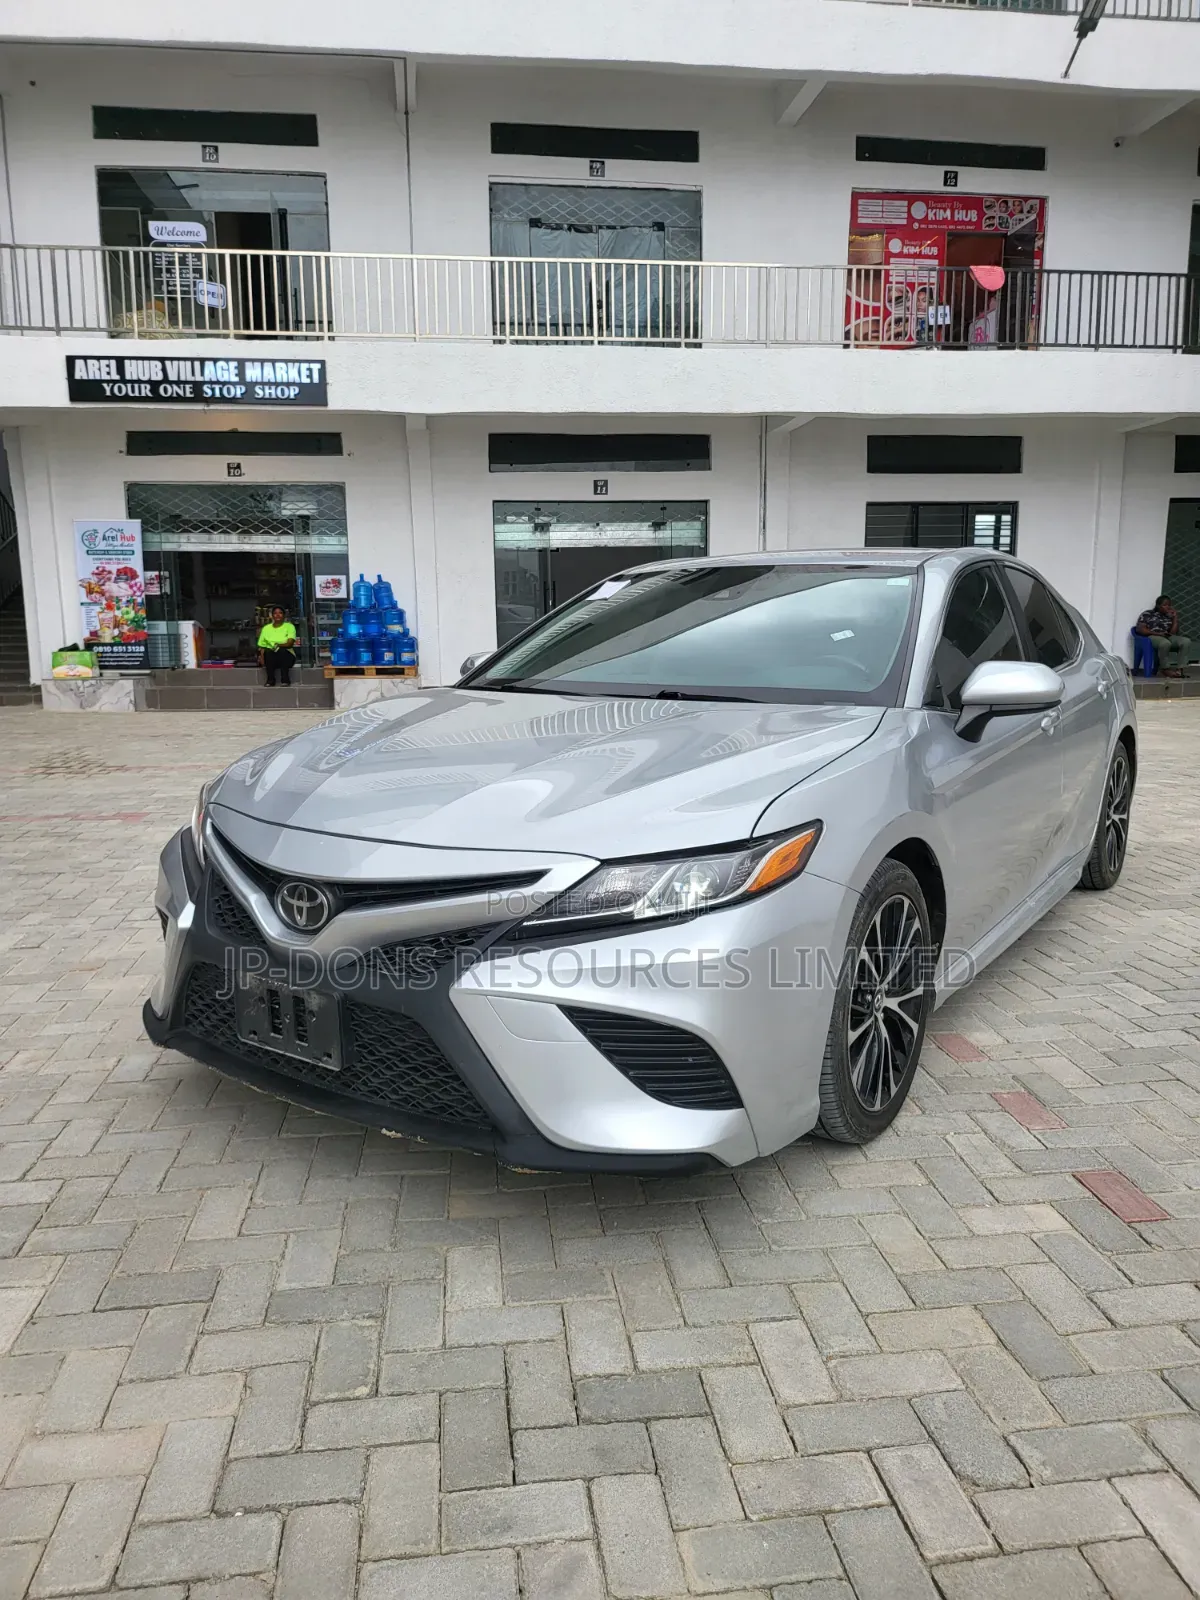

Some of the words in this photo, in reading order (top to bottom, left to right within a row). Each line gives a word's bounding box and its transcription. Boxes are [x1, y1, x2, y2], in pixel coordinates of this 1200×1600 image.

[205, 153, 216, 161] 10
[946, 178, 956, 186] 12
[928, 208, 951, 221] KIM
[954, 209, 978, 222] HUB
[154, 225, 202, 238] Welcome
[903, 247, 921, 255] KIM
[921, 246, 938, 256] HUB
[74, 359, 120, 380] AREL
[124, 359, 164, 381] HUB
[164, 360, 239, 382] VILLAGE
[245, 361, 321, 383] MARKET
[102, 382, 153, 397] YOUR
[159, 383, 194, 398] ONE
[202, 384, 246, 399] STOP
[254, 385, 300, 399] SHOP
[229, 468, 241, 476] 10
[596, 486, 606, 494] 11
[102, 533, 119, 542] Arel
[120, 533, 136, 542] Hub
